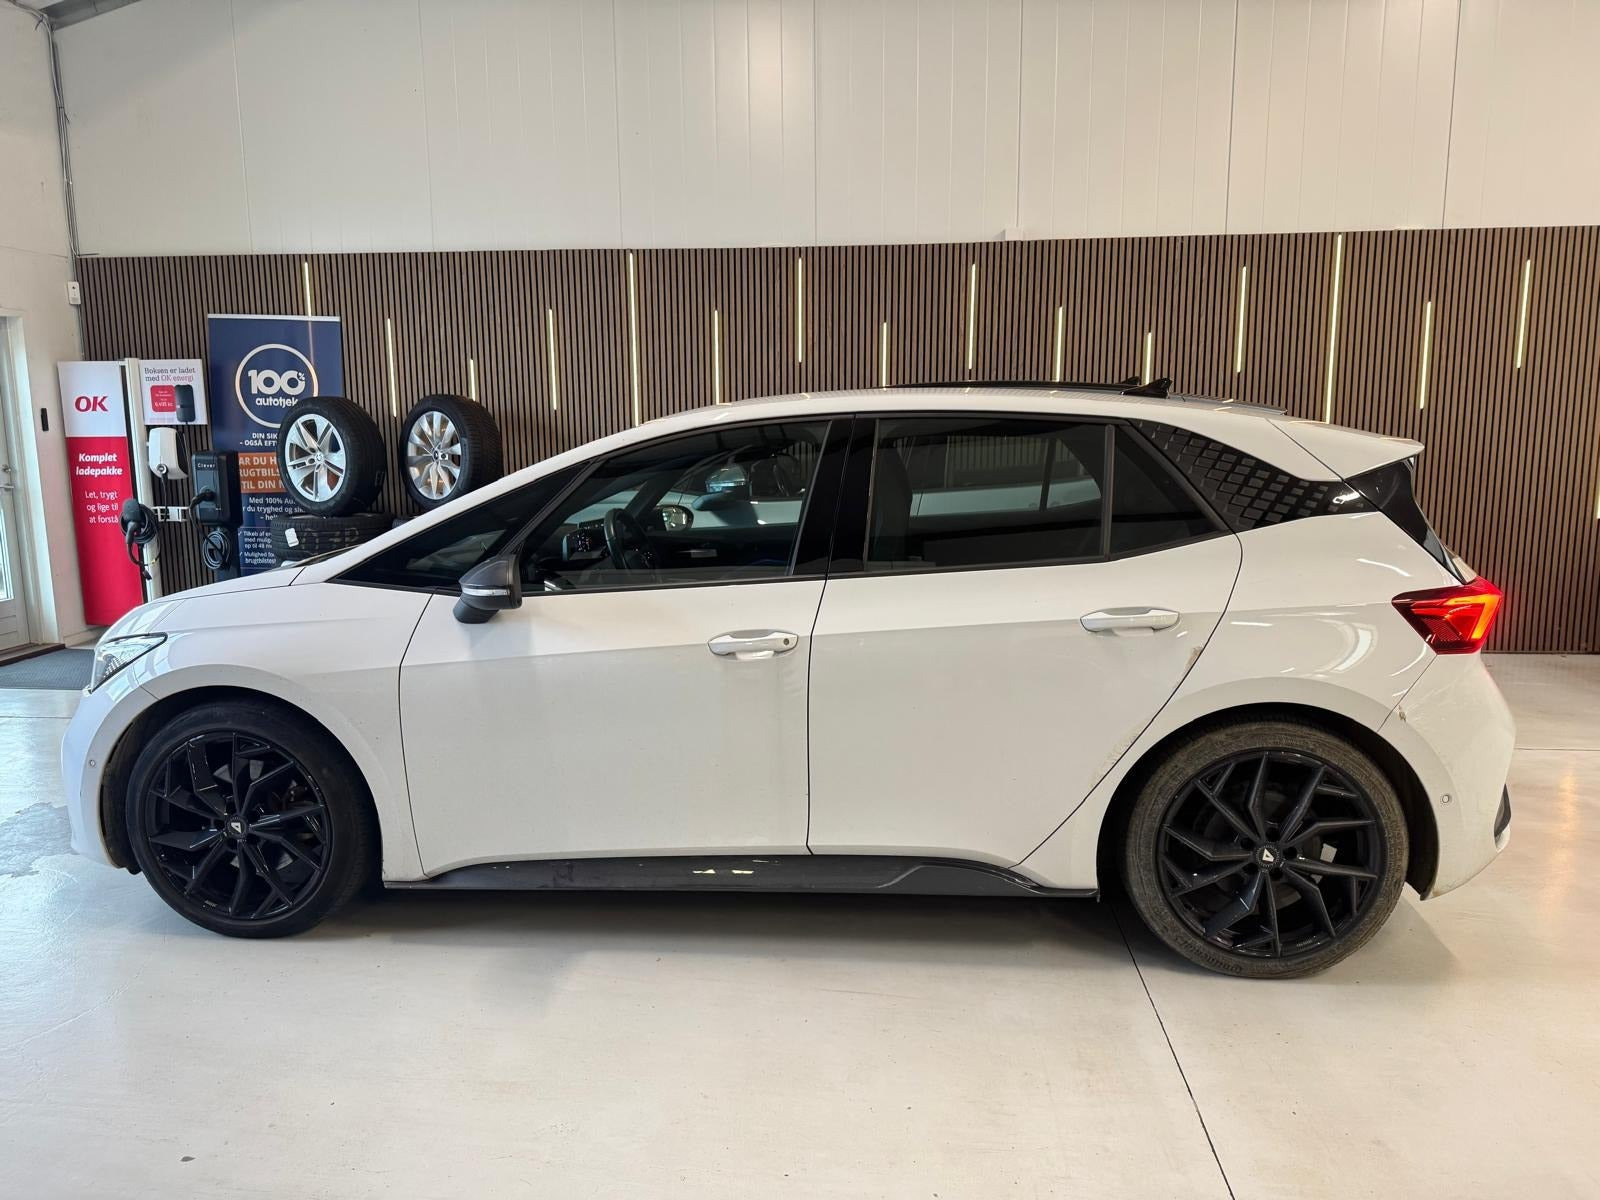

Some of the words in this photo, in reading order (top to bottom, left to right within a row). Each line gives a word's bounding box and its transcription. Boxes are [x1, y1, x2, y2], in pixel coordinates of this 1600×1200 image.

[248, 369, 305, 395] 100%
[74, 396, 108, 412] OK
[79, 453, 117, 464] Komplet
[253, 456, 266, 465] DU
[76, 467, 123, 477] ladepakke
[242, 481, 255, 489] TIL
[258, 480, 275, 488] DIN
[100, 491, 118, 500] trygt
[87, 504, 96, 513] og
[97, 503, 110, 512] lige
[98, 514, 119, 524] forstå
